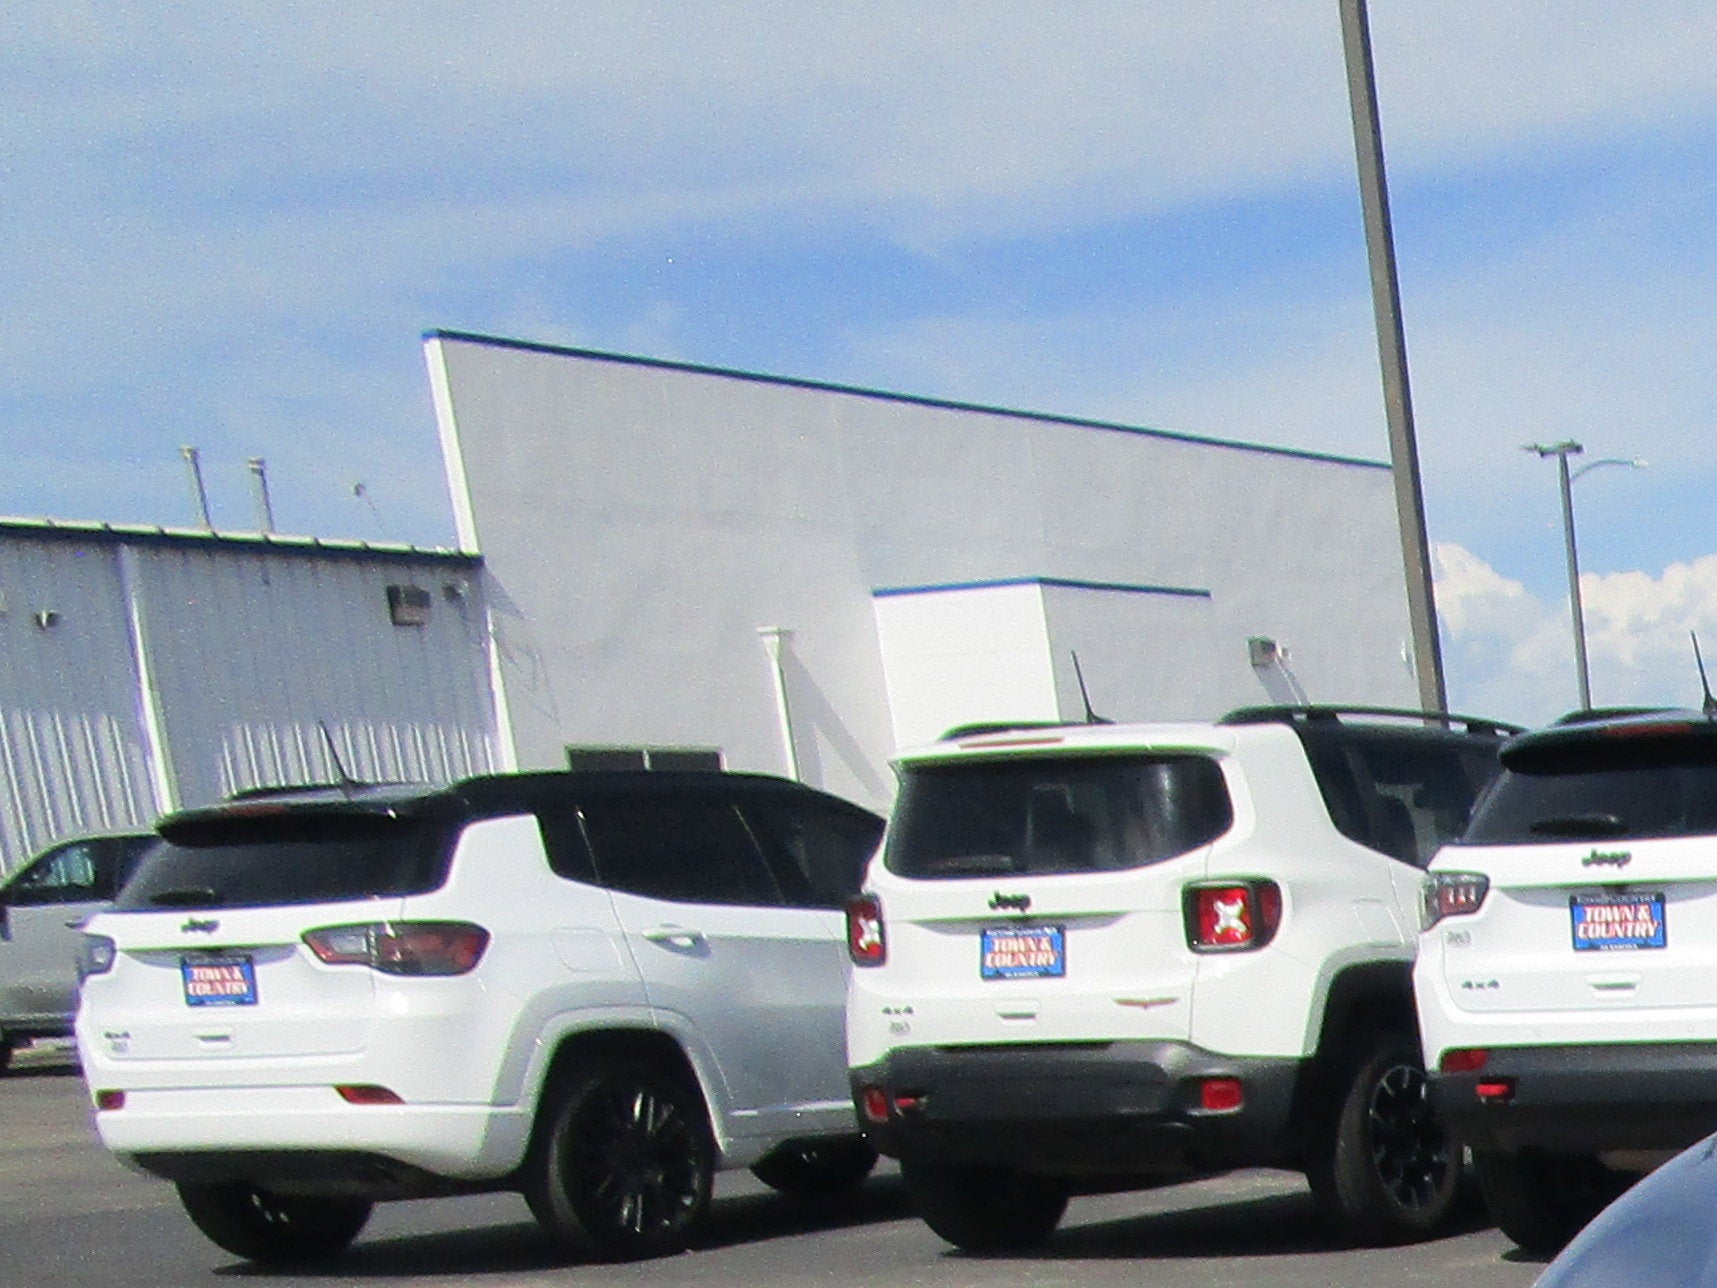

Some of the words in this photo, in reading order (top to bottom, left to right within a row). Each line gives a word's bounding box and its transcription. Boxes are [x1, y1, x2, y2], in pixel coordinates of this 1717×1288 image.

[1581, 848, 1633, 869] Jeep
[987, 890, 1032, 914] Jeep
[1583, 904, 1635, 922] TOWN
[1577, 921, 1661, 940] COUNTRY
[992, 937, 1038, 953] TOWN
[985, 951, 1058, 968] COUNTRY
